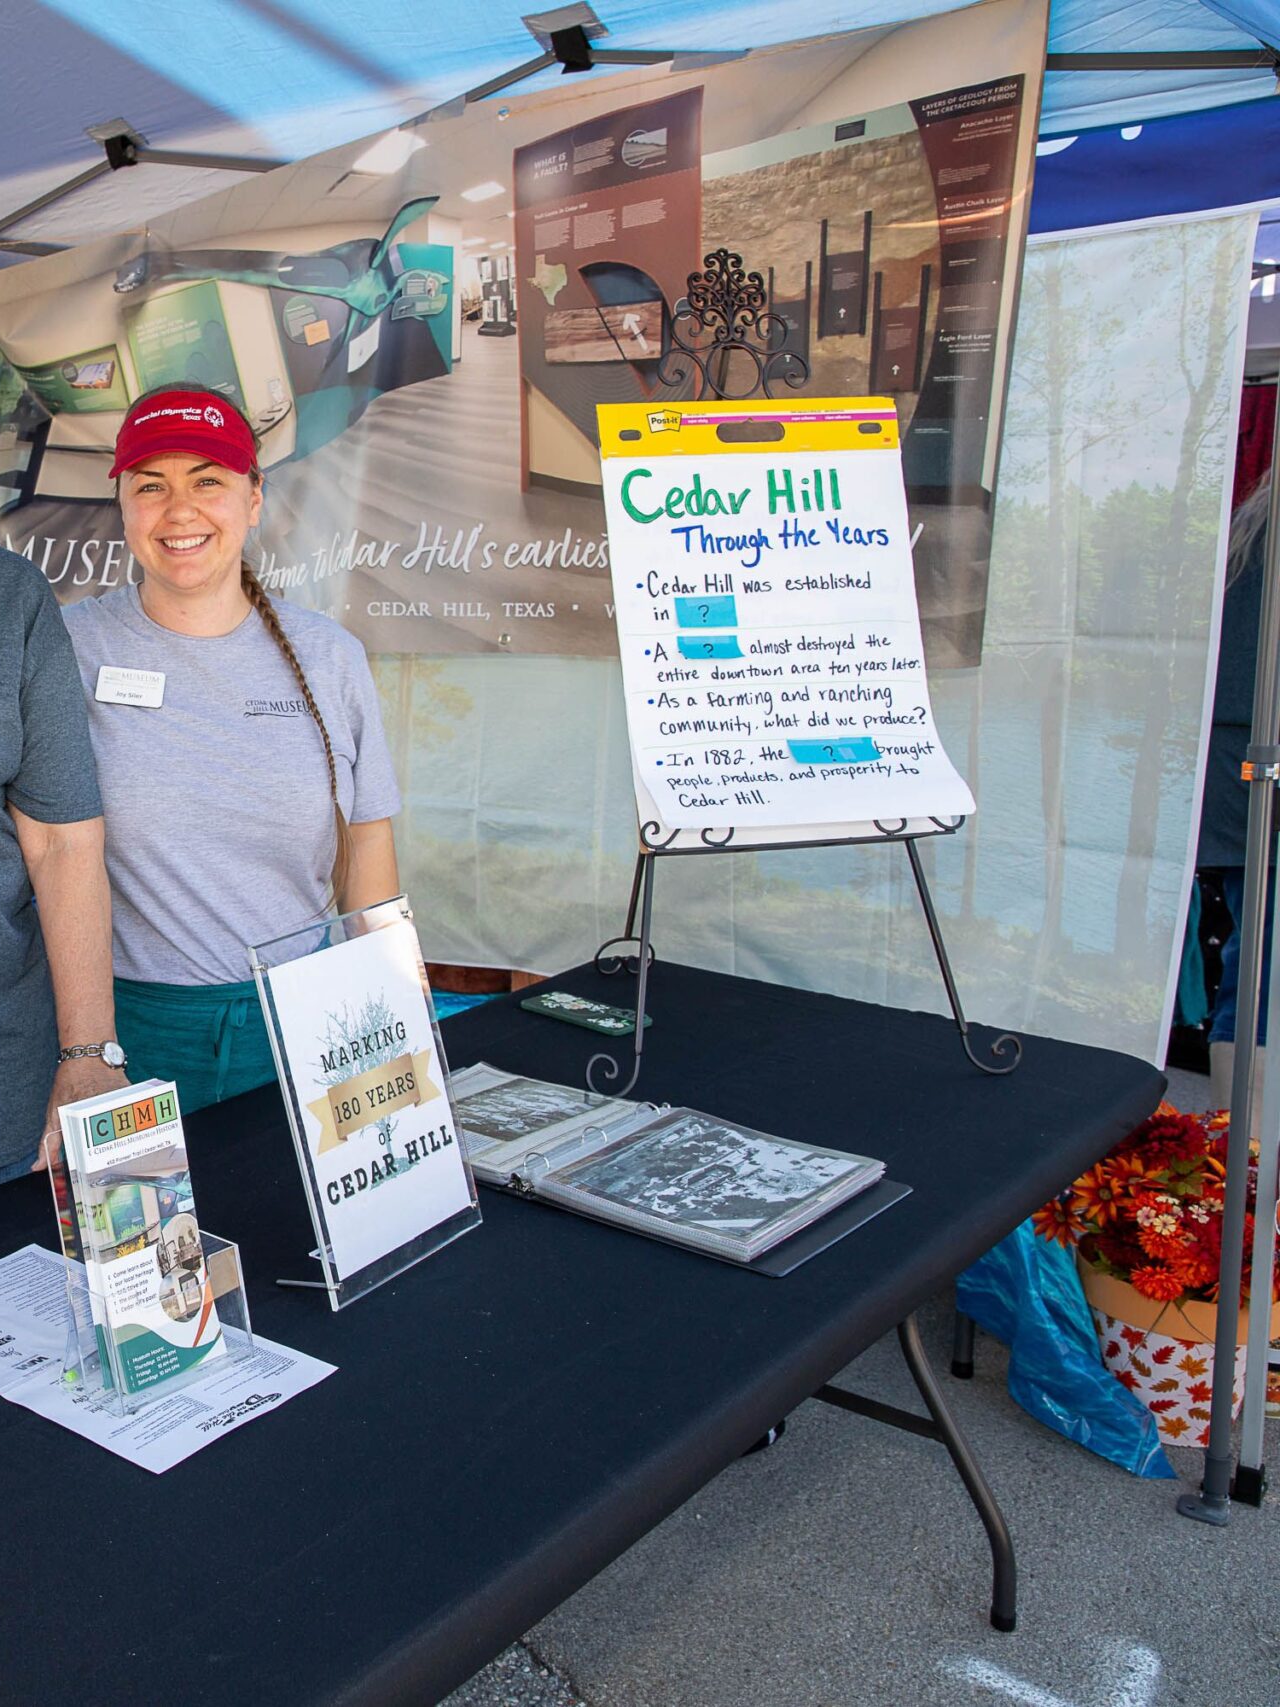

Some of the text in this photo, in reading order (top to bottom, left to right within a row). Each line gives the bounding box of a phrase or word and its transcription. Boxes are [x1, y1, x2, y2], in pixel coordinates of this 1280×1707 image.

[921, 83, 1018, 111] LAYERS OF GEOLOGY FROM
[940, 98, 987, 114] CRETACEOUS
[987, 91, 1017, 103] PERIOD
[534, 152, 567, 169] WHAT IS
[541, 162, 569, 177] FAULT?
[134, 407, 201, 425] Special Olympics
[651, 415, 679, 425] Post-it
[621, 469, 842, 524] Cedar Hill
[257, 550, 308, 590] Home
[401, 520, 493, 575] Hill's
[671, 518, 889, 569] Through the Years
[647, 570, 871, 598] Cedar Hill was established
[367, 602, 555, 621] CEDAR HILL, TEXAS
[654, 604, 710, 623] in ?
[653, 642, 668, 663] A
[750, 636, 793, 656] almost
[797, 632, 855, 655] destroyed
[865, 634, 892, 649] the
[657, 666, 700, 683] entire
[791, 663, 821, 675] area
[828, 660, 850, 675] ten
[855, 660, 888, 676] years
[269, 700, 310, 713] MUSEU
[657, 684, 893, 715] As a farming and ranching
[763, 713, 801, 729] what
[807, 711, 830, 727] did
[837, 714, 857, 727] we
[863, 706, 927, 729] produce?
[666, 753, 694, 767] In
[759, 746, 789, 761] the
[873, 741, 935, 762] brought
[789, 765, 816, 781] and
[820, 762, 892, 781] prosperity
[897, 764, 920, 776] to
[678, 789, 771, 808] Cedar Hill.
[320, 1021, 407, 1073] MARKING
[335, 1072, 415, 1124] 180 YEARS
[378, 1123, 392, 1146] of
[326, 1153, 398, 1206] CEDAR
[405, 1124, 453, 1165] HILL
